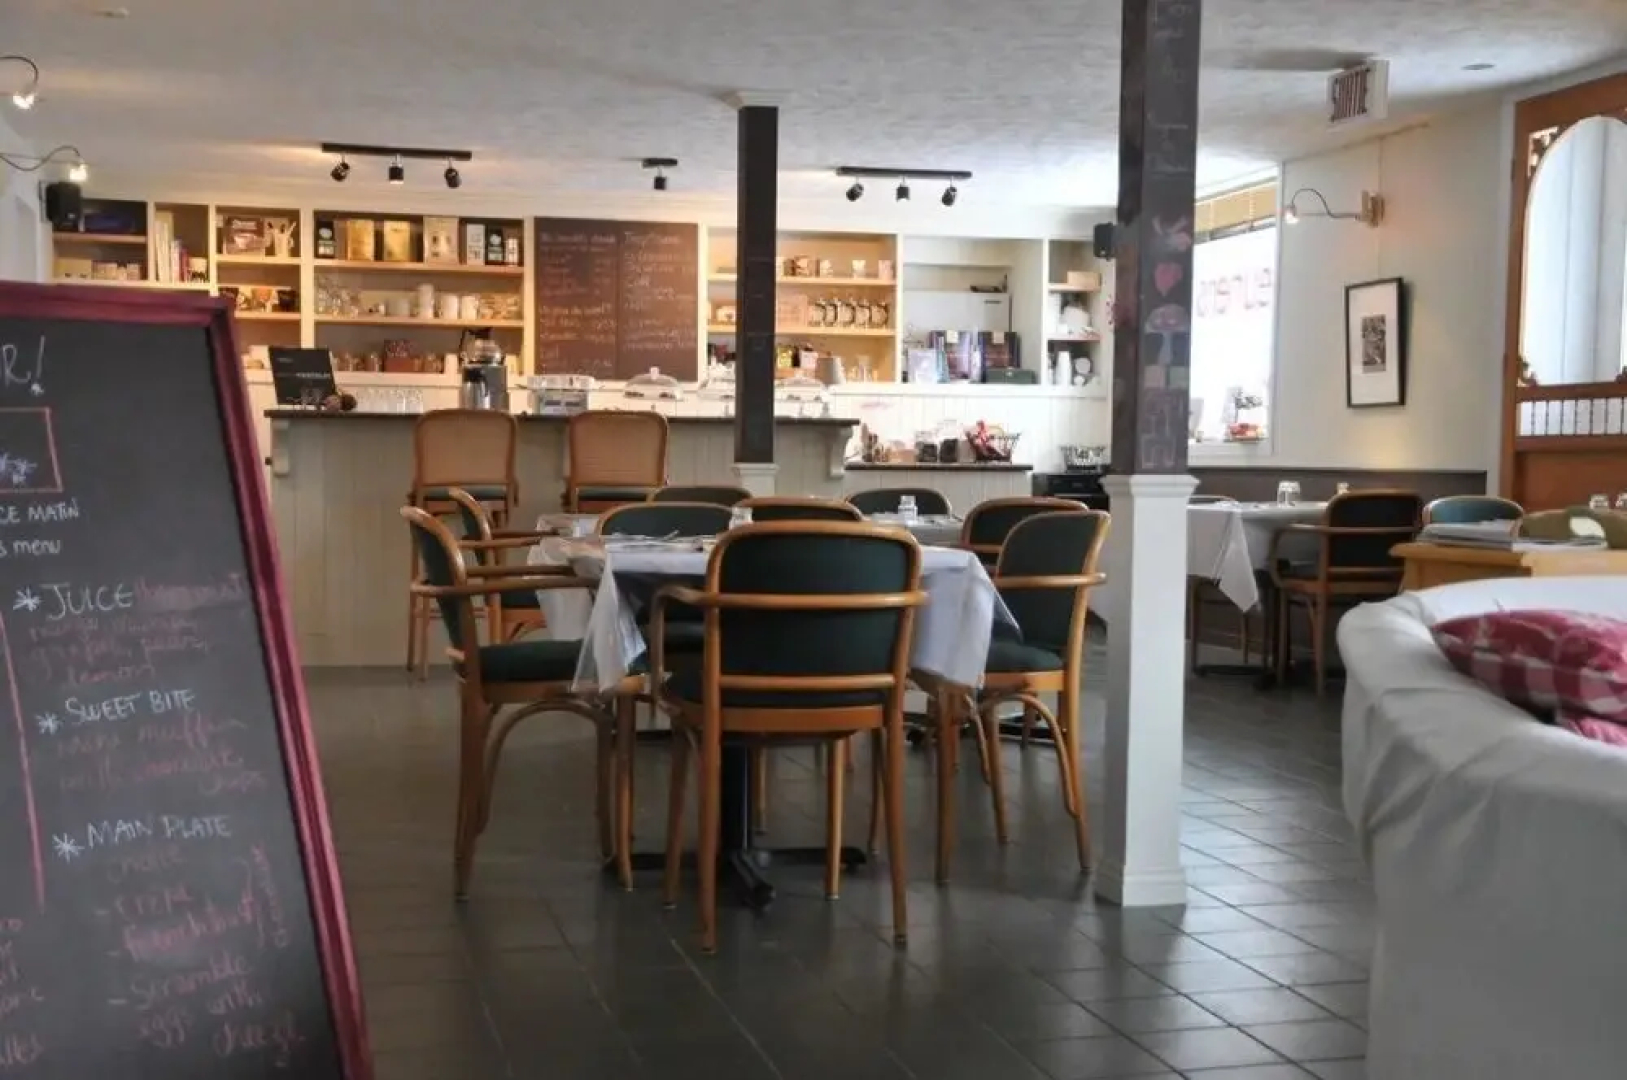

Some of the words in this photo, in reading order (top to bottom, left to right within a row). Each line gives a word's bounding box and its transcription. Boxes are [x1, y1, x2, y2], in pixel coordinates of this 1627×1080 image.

[28, 497, 79, 522] MATIN
[13, 539, 61, 556] menu
[40, 583, 133, 621] JUICE
[65, 692, 142, 726] SWEET
[149, 688, 196, 713] BITE
[88, 819, 151, 848] MAIN
[162, 815, 231, 840] PLATE
